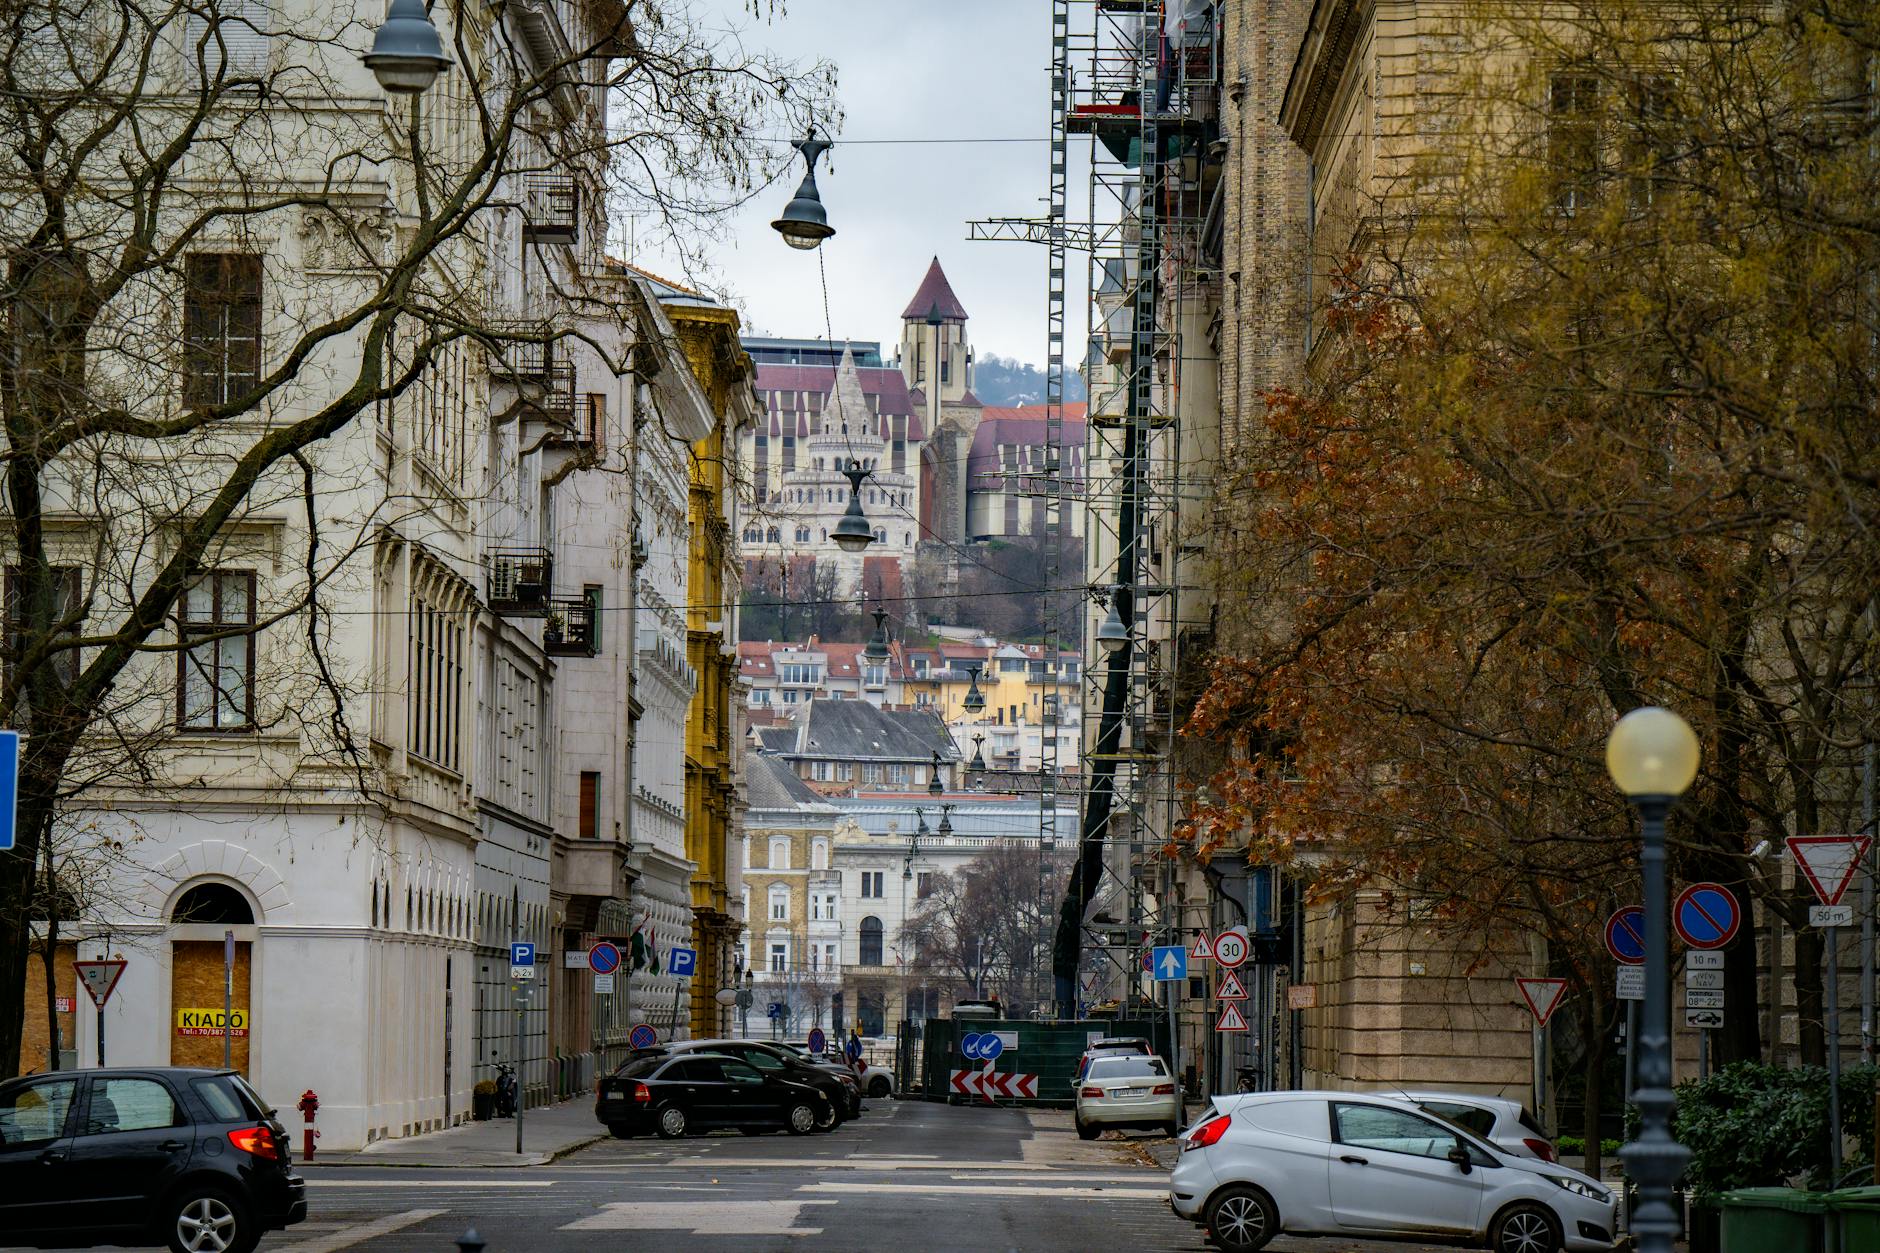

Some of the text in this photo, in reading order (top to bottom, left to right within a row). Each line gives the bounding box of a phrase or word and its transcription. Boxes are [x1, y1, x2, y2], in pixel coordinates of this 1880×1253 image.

[1818, 911, 1830, 921] 50
[516, 947, 529, 962] P
[1222, 943, 1239, 957] 30
[674, 951, 691, 972] P
[1694, 955, 1704, 964] 10
[768, 1004, 776, 1015] P
[183, 1011, 243, 1028] KIADÓ
